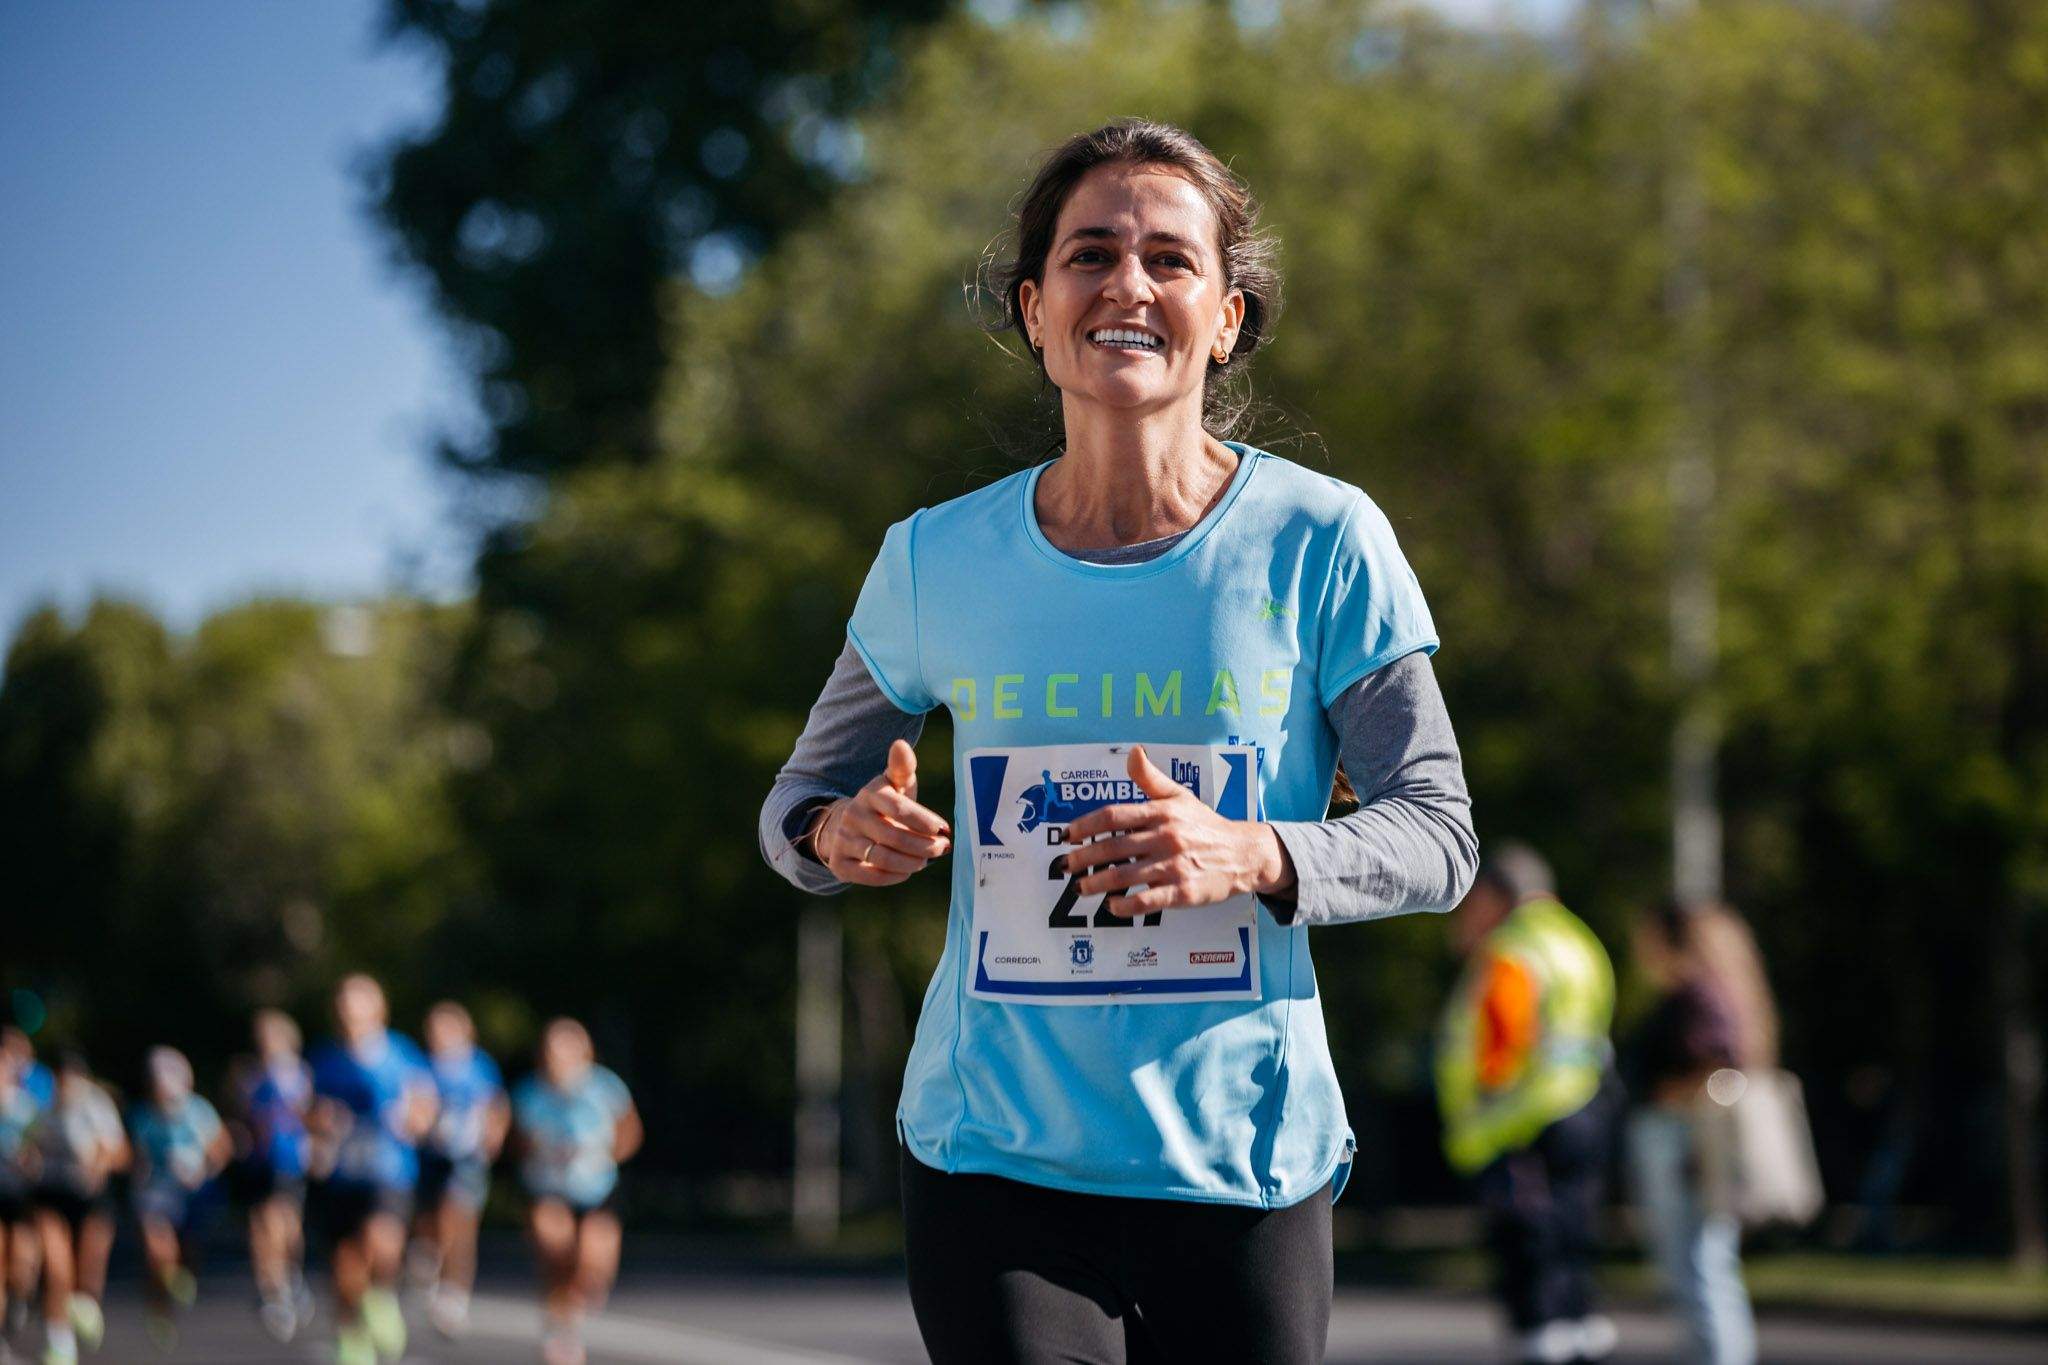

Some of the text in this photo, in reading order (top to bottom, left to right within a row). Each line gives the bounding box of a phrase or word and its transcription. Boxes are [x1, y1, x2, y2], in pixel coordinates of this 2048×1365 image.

[950, 669, 1292, 722] DECIMAS
[1060, 769, 1109, 781] CARRERA
[1060, 782, 1194, 801] BOMBE
